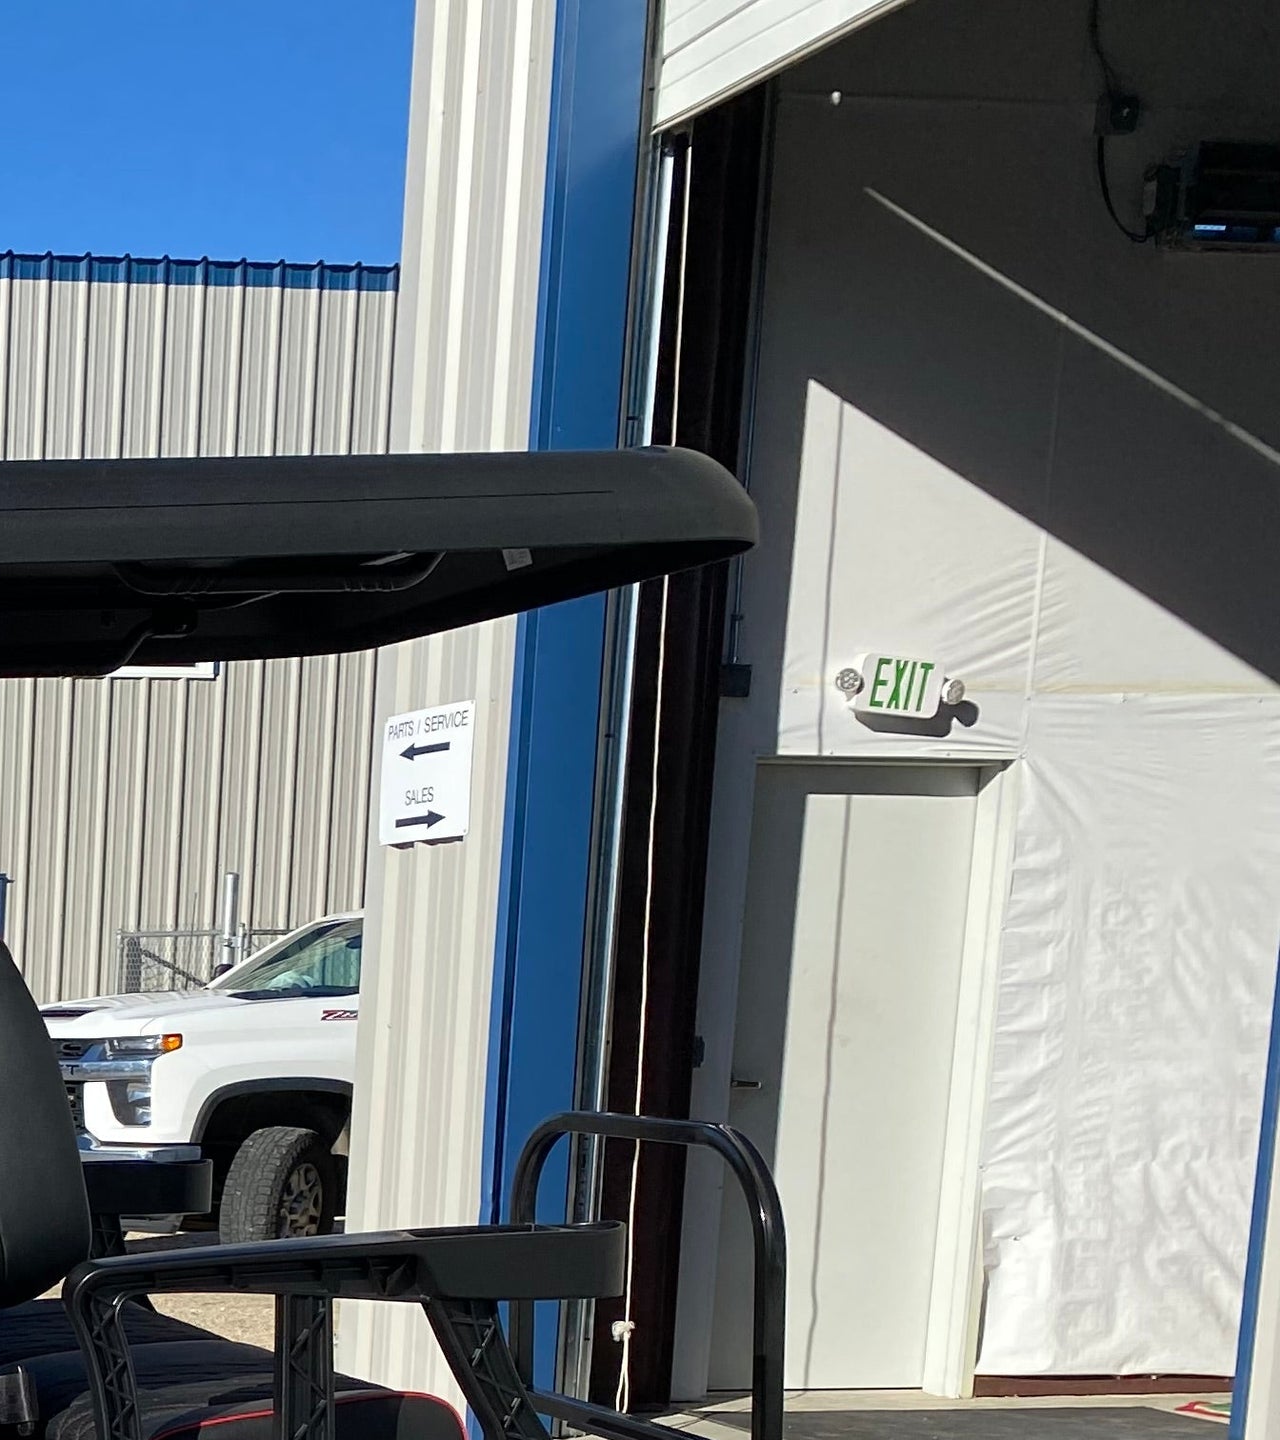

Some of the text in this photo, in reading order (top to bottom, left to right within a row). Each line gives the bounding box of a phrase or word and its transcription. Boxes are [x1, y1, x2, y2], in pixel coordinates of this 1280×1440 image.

[869, 657, 935, 712] EXIT
[388, 720, 415, 741] PARTS
[424, 709, 469, 734] SERVICE
[405, 786, 434, 806] SALES
